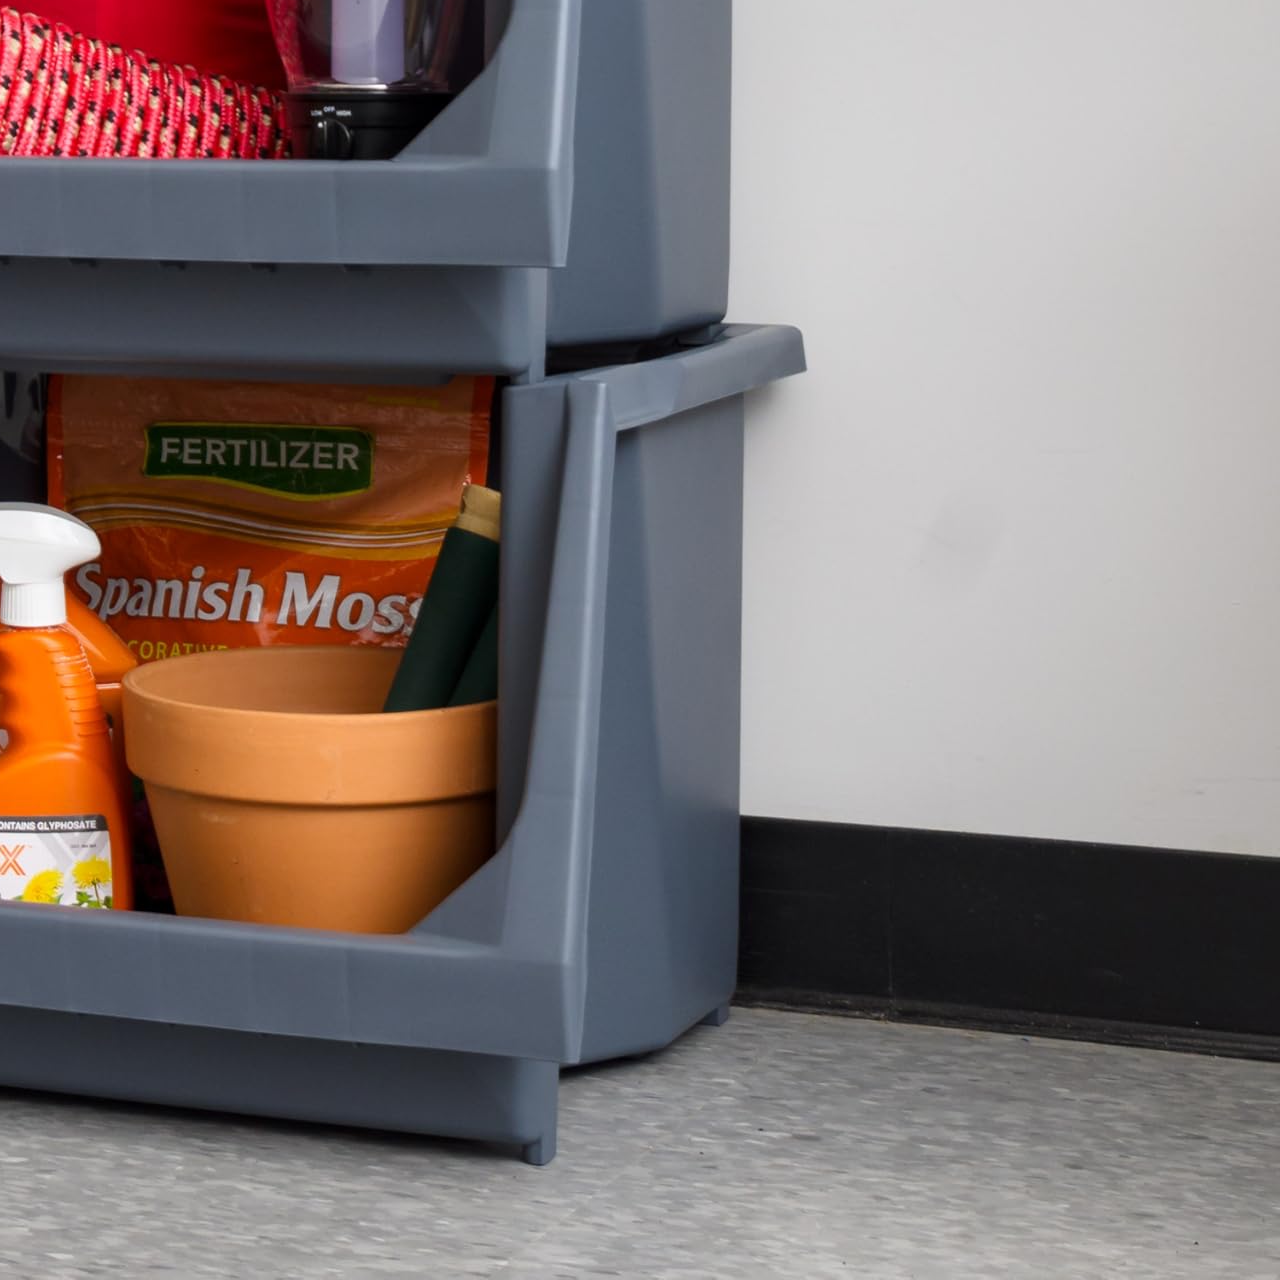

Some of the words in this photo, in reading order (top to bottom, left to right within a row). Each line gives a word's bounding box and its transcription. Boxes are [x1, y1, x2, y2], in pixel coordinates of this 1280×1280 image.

[160, 436, 360, 470] FERTILIZER
[76, 563, 265, 623] Spanish
[36, 819, 97, 830] GLYPHOSATE
